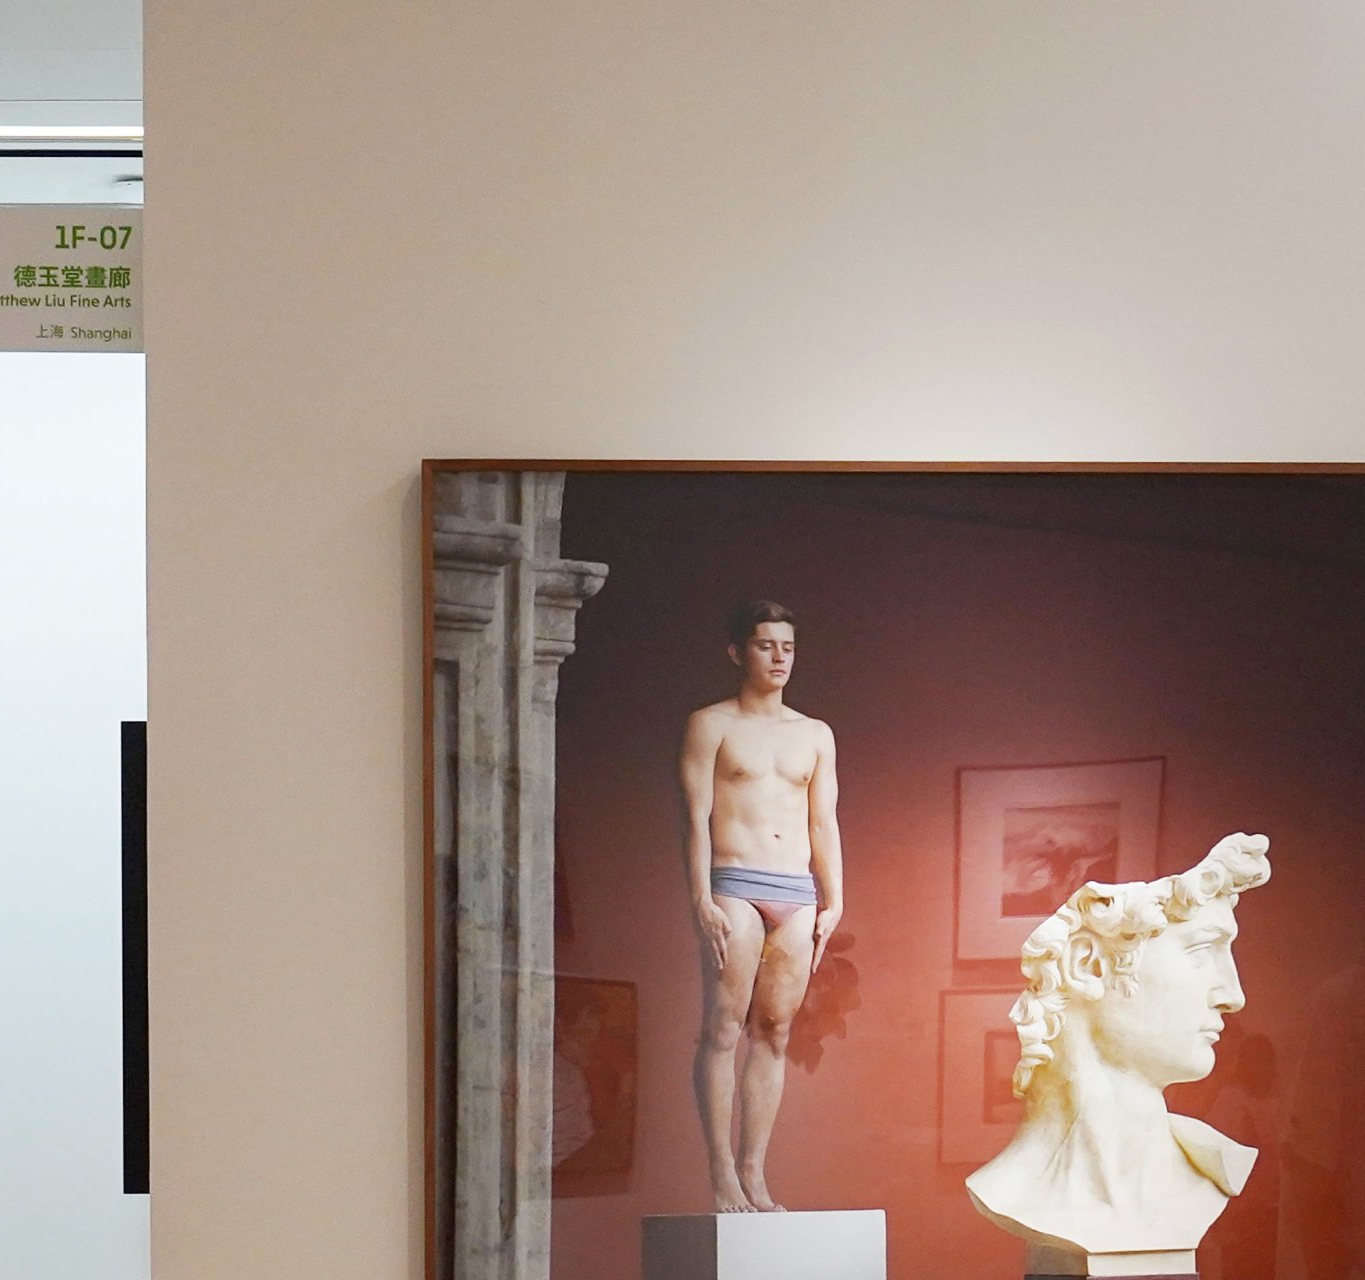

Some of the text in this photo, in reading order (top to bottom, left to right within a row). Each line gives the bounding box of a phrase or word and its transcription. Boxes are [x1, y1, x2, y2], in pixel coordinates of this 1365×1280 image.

[55, 225, 132, 250] 1F-07
[13, 265, 132, 289] 德玉堂畫廊
[45, 294, 66, 307] Liu
[70, 295, 100, 308] Fine
[103, 295, 132, 308] Arts
[36, 324, 132, 342] 上海 Shanghai
